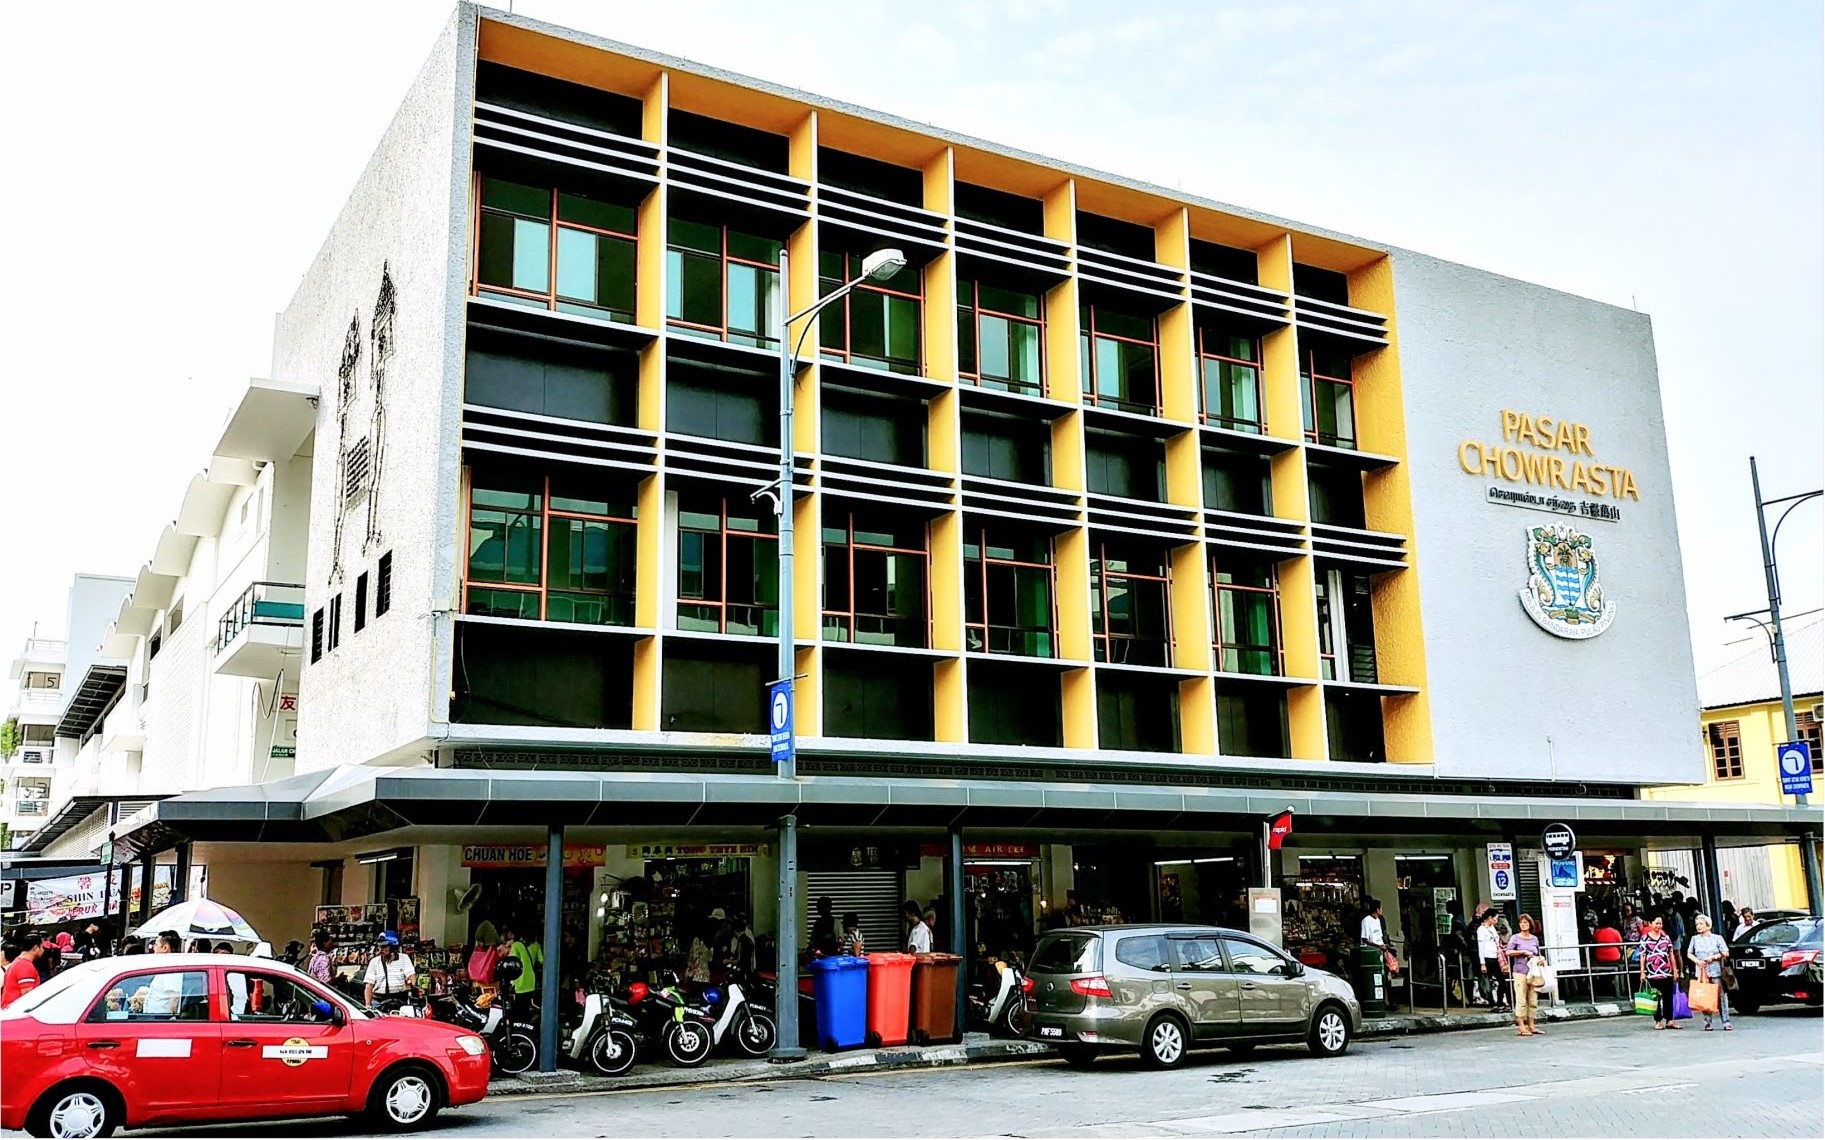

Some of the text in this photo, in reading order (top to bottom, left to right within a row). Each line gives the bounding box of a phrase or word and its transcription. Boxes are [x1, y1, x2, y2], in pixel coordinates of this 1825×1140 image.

[1502, 409, 1594, 456] PASAR
[1458, 440, 1640, 501] CHOWRASTA
[47, 676, 56, 688] 5
[280, 695, 297, 711] 友
[1272, 826, 1287, 834] rapid
[464, 847, 532, 861] CHUAN HOE
[1498, 877, 1507, 887] 12
[67, 891, 94, 902] SHIN
[66, 904, 98, 917] JERUK
